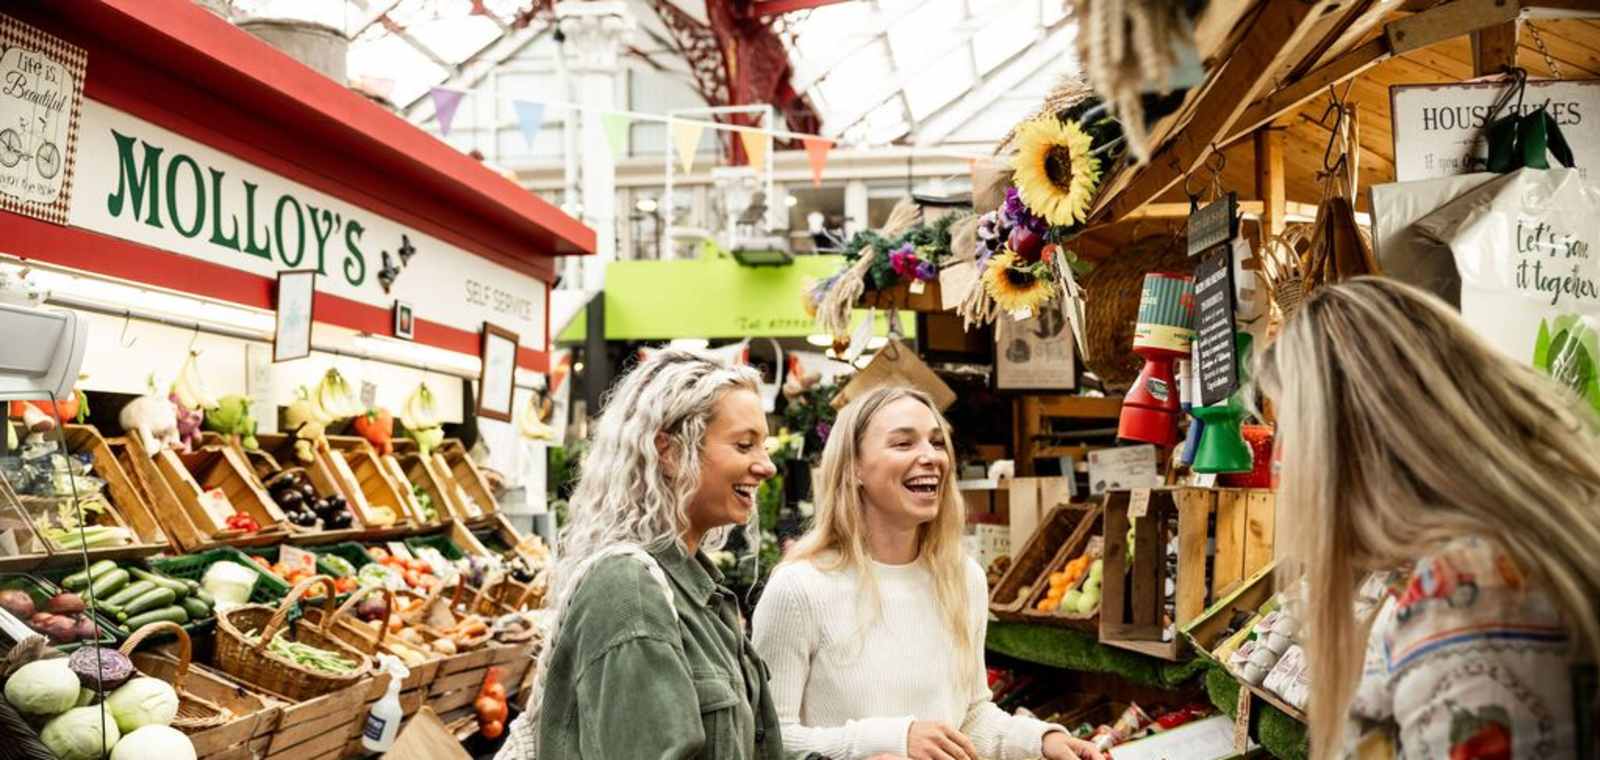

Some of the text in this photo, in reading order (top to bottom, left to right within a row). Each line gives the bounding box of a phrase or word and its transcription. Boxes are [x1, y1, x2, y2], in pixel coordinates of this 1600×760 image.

[17, 52, 57, 83] Life is
[3, 70, 67, 114] Beautiful
[108, 128, 366, 287] MOLLOY'S
[1517, 221, 1556, 257] Let's
[465, 278, 532, 321] SELF SERVICE
[1516, 259, 1598, 306] it together
